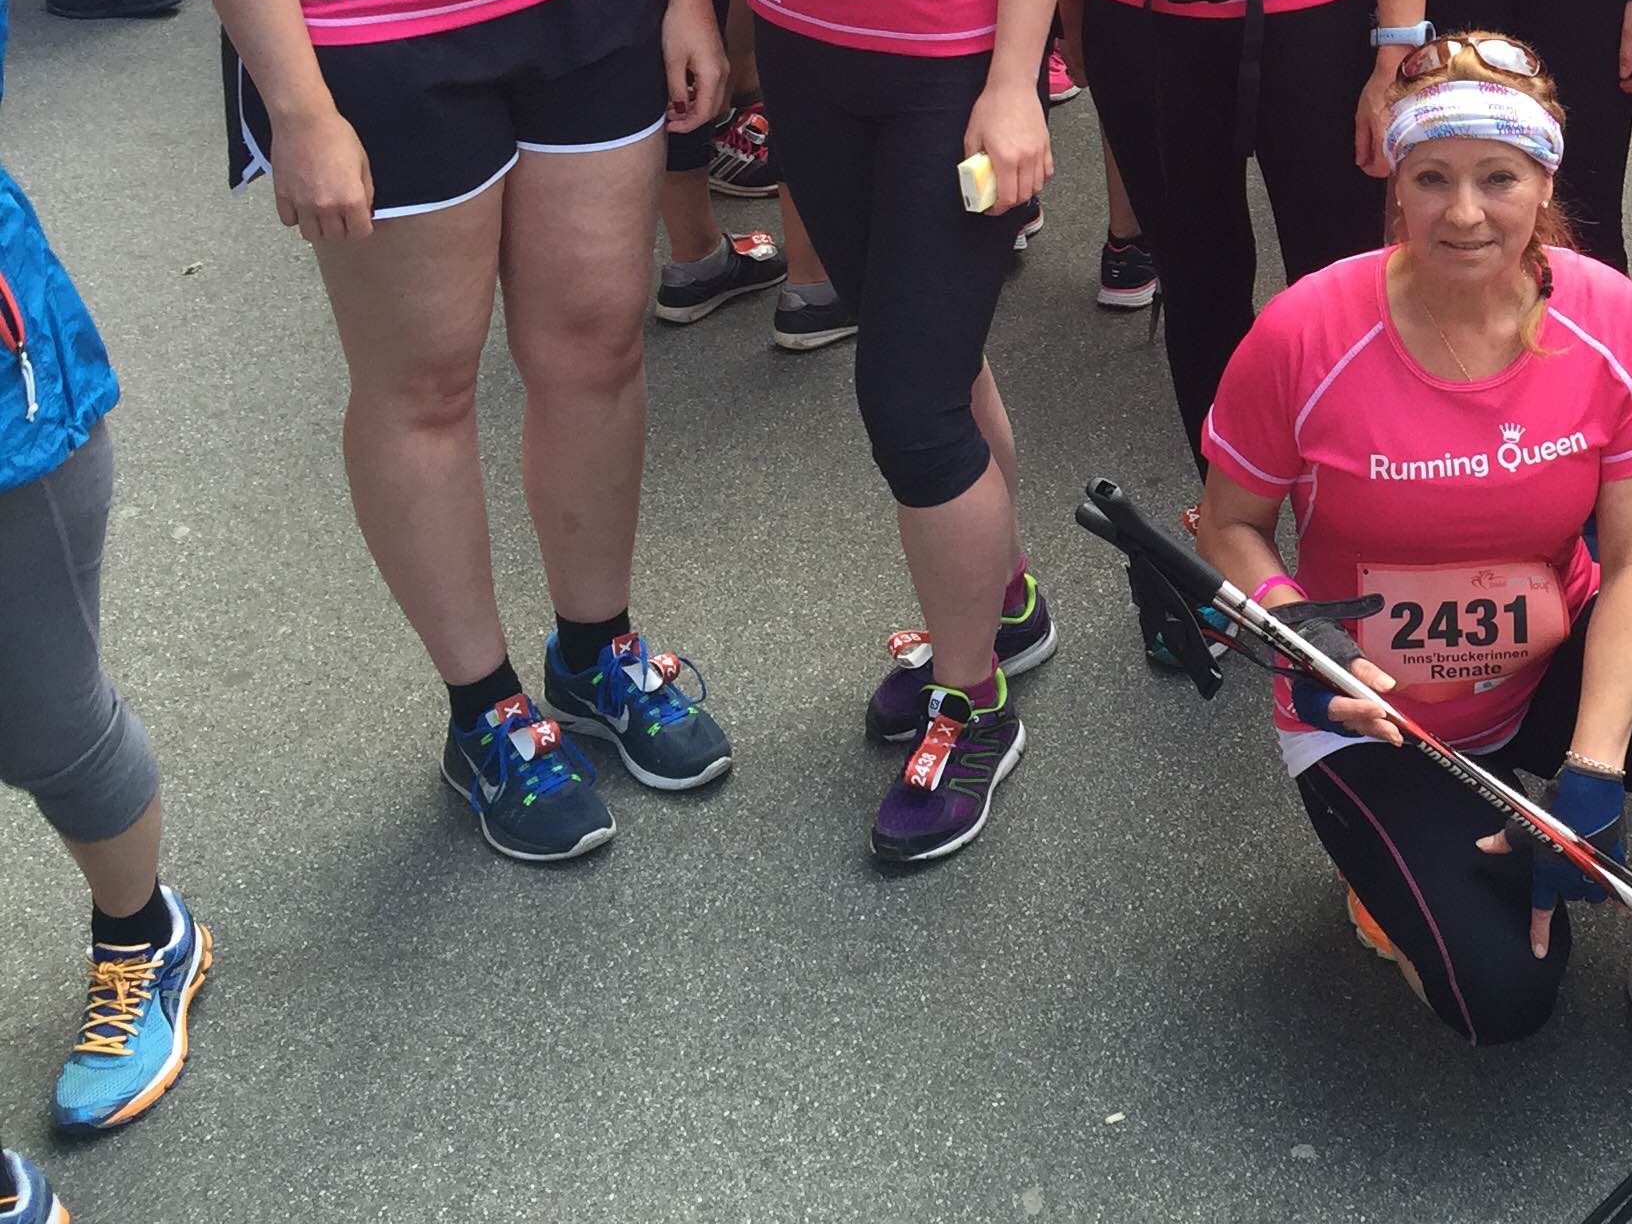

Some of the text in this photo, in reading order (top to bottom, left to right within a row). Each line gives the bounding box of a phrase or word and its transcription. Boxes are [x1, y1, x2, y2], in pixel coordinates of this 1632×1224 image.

[1370, 431, 1588, 480] Running Queen
[1390, 594, 1528, 650] 2431
[1403, 649, 1528, 665] Inns'bruckerinnen
[1430, 662, 1502, 680] Renate
[911, 752, 937, 787] 2438
